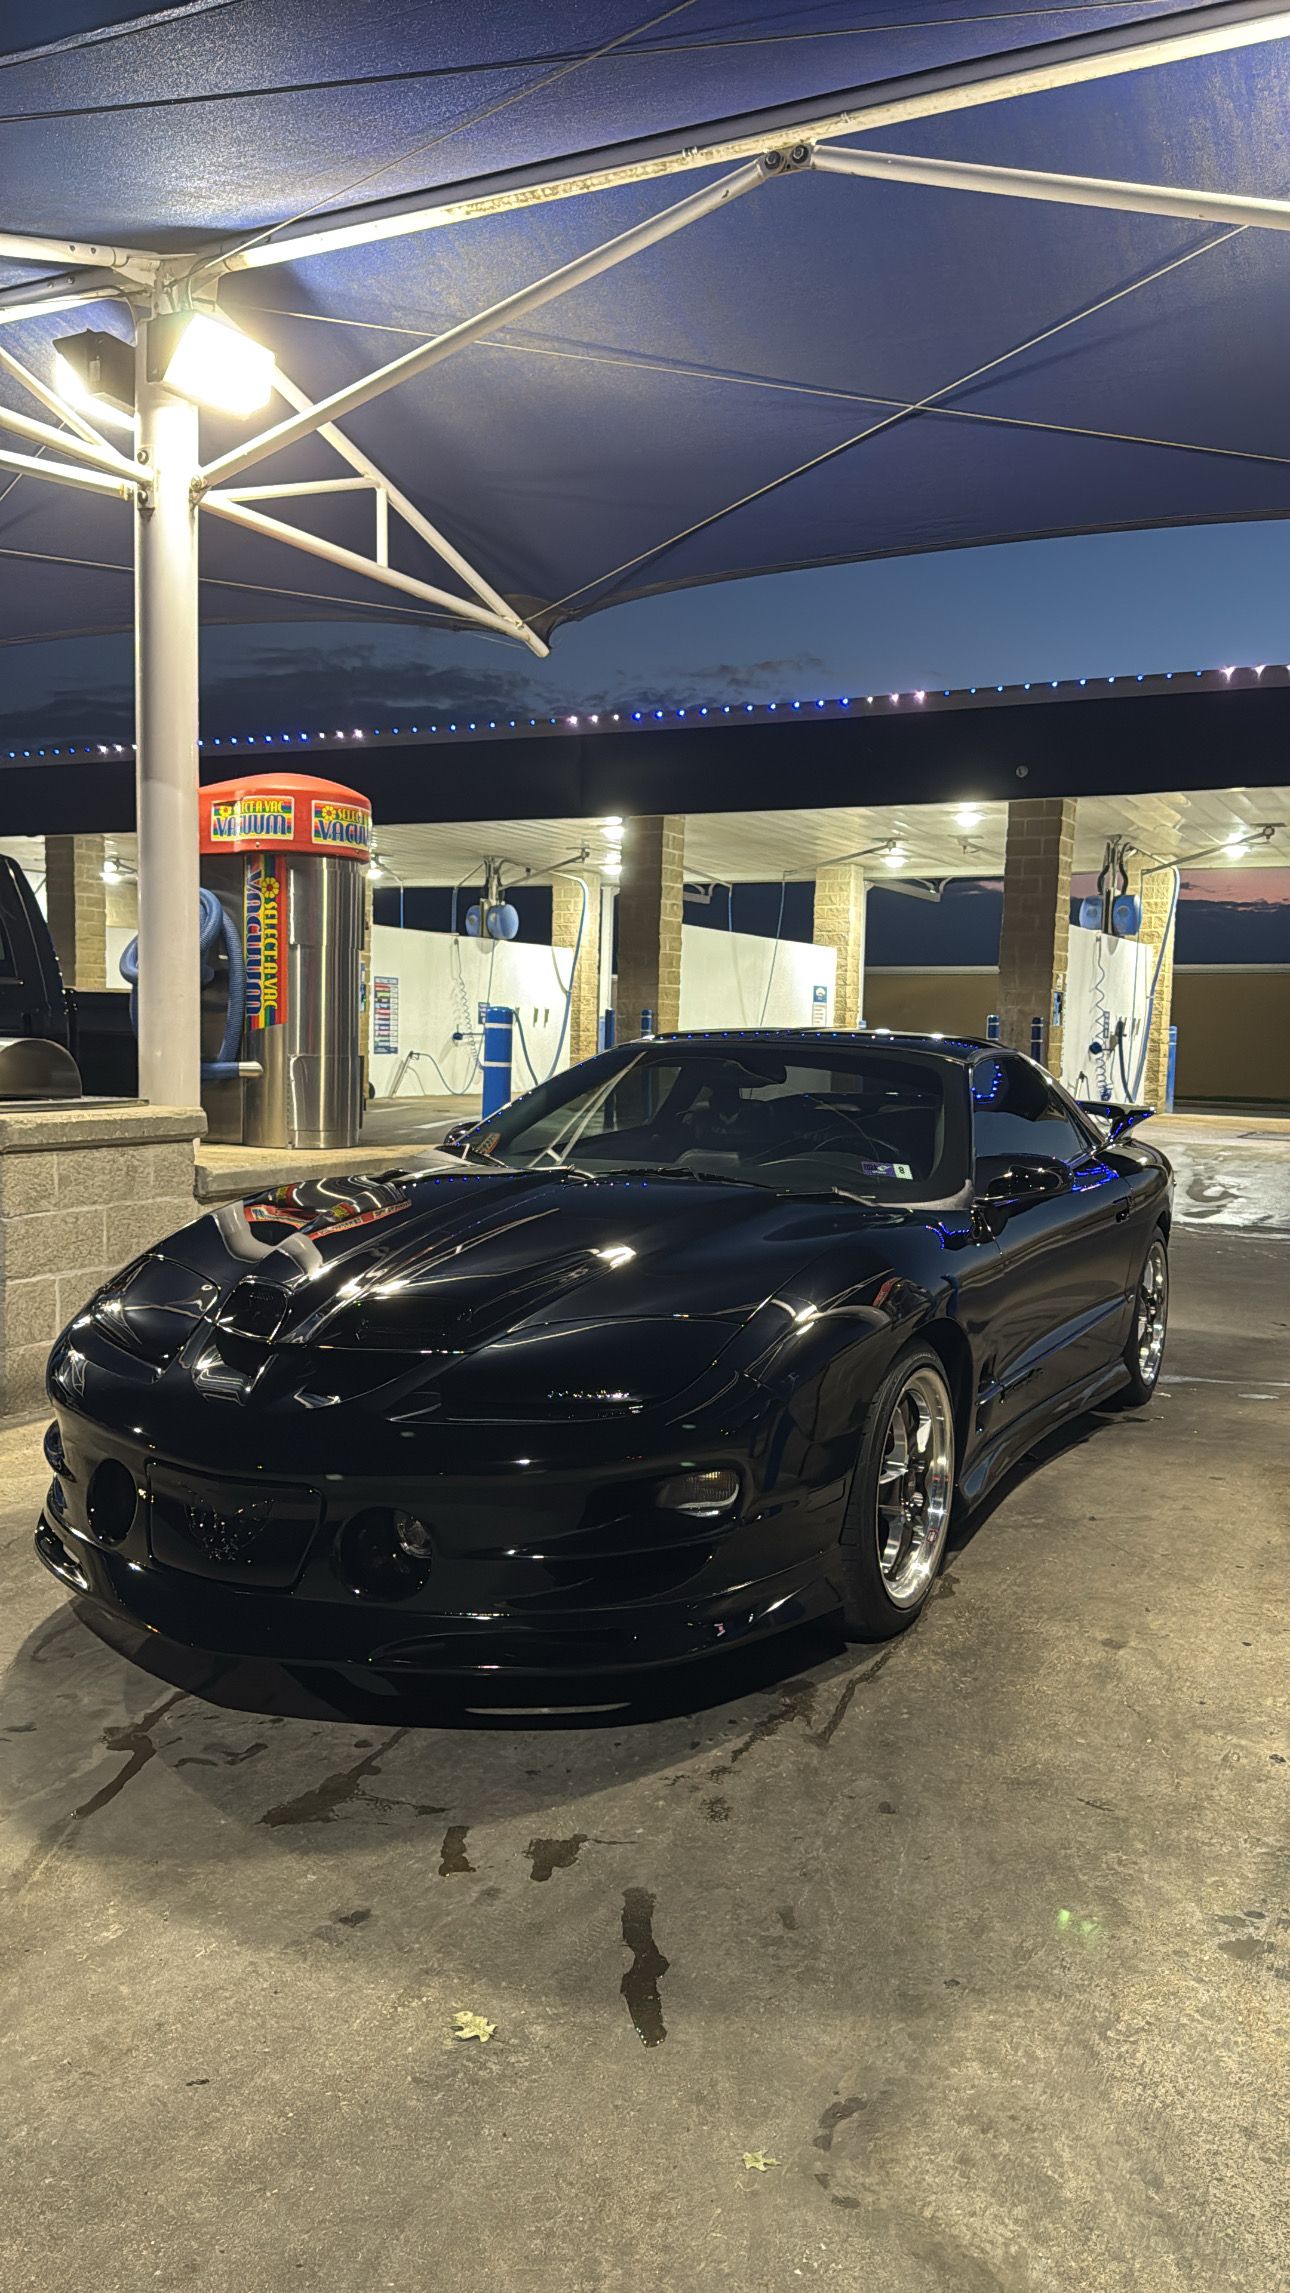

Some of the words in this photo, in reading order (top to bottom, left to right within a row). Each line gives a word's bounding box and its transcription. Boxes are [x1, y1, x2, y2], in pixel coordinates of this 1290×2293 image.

[234, 800, 284, 814] ECT-A-VAC
[216, 814, 287, 837] VAUUM
[245, 869, 263, 1016] VACUUM
